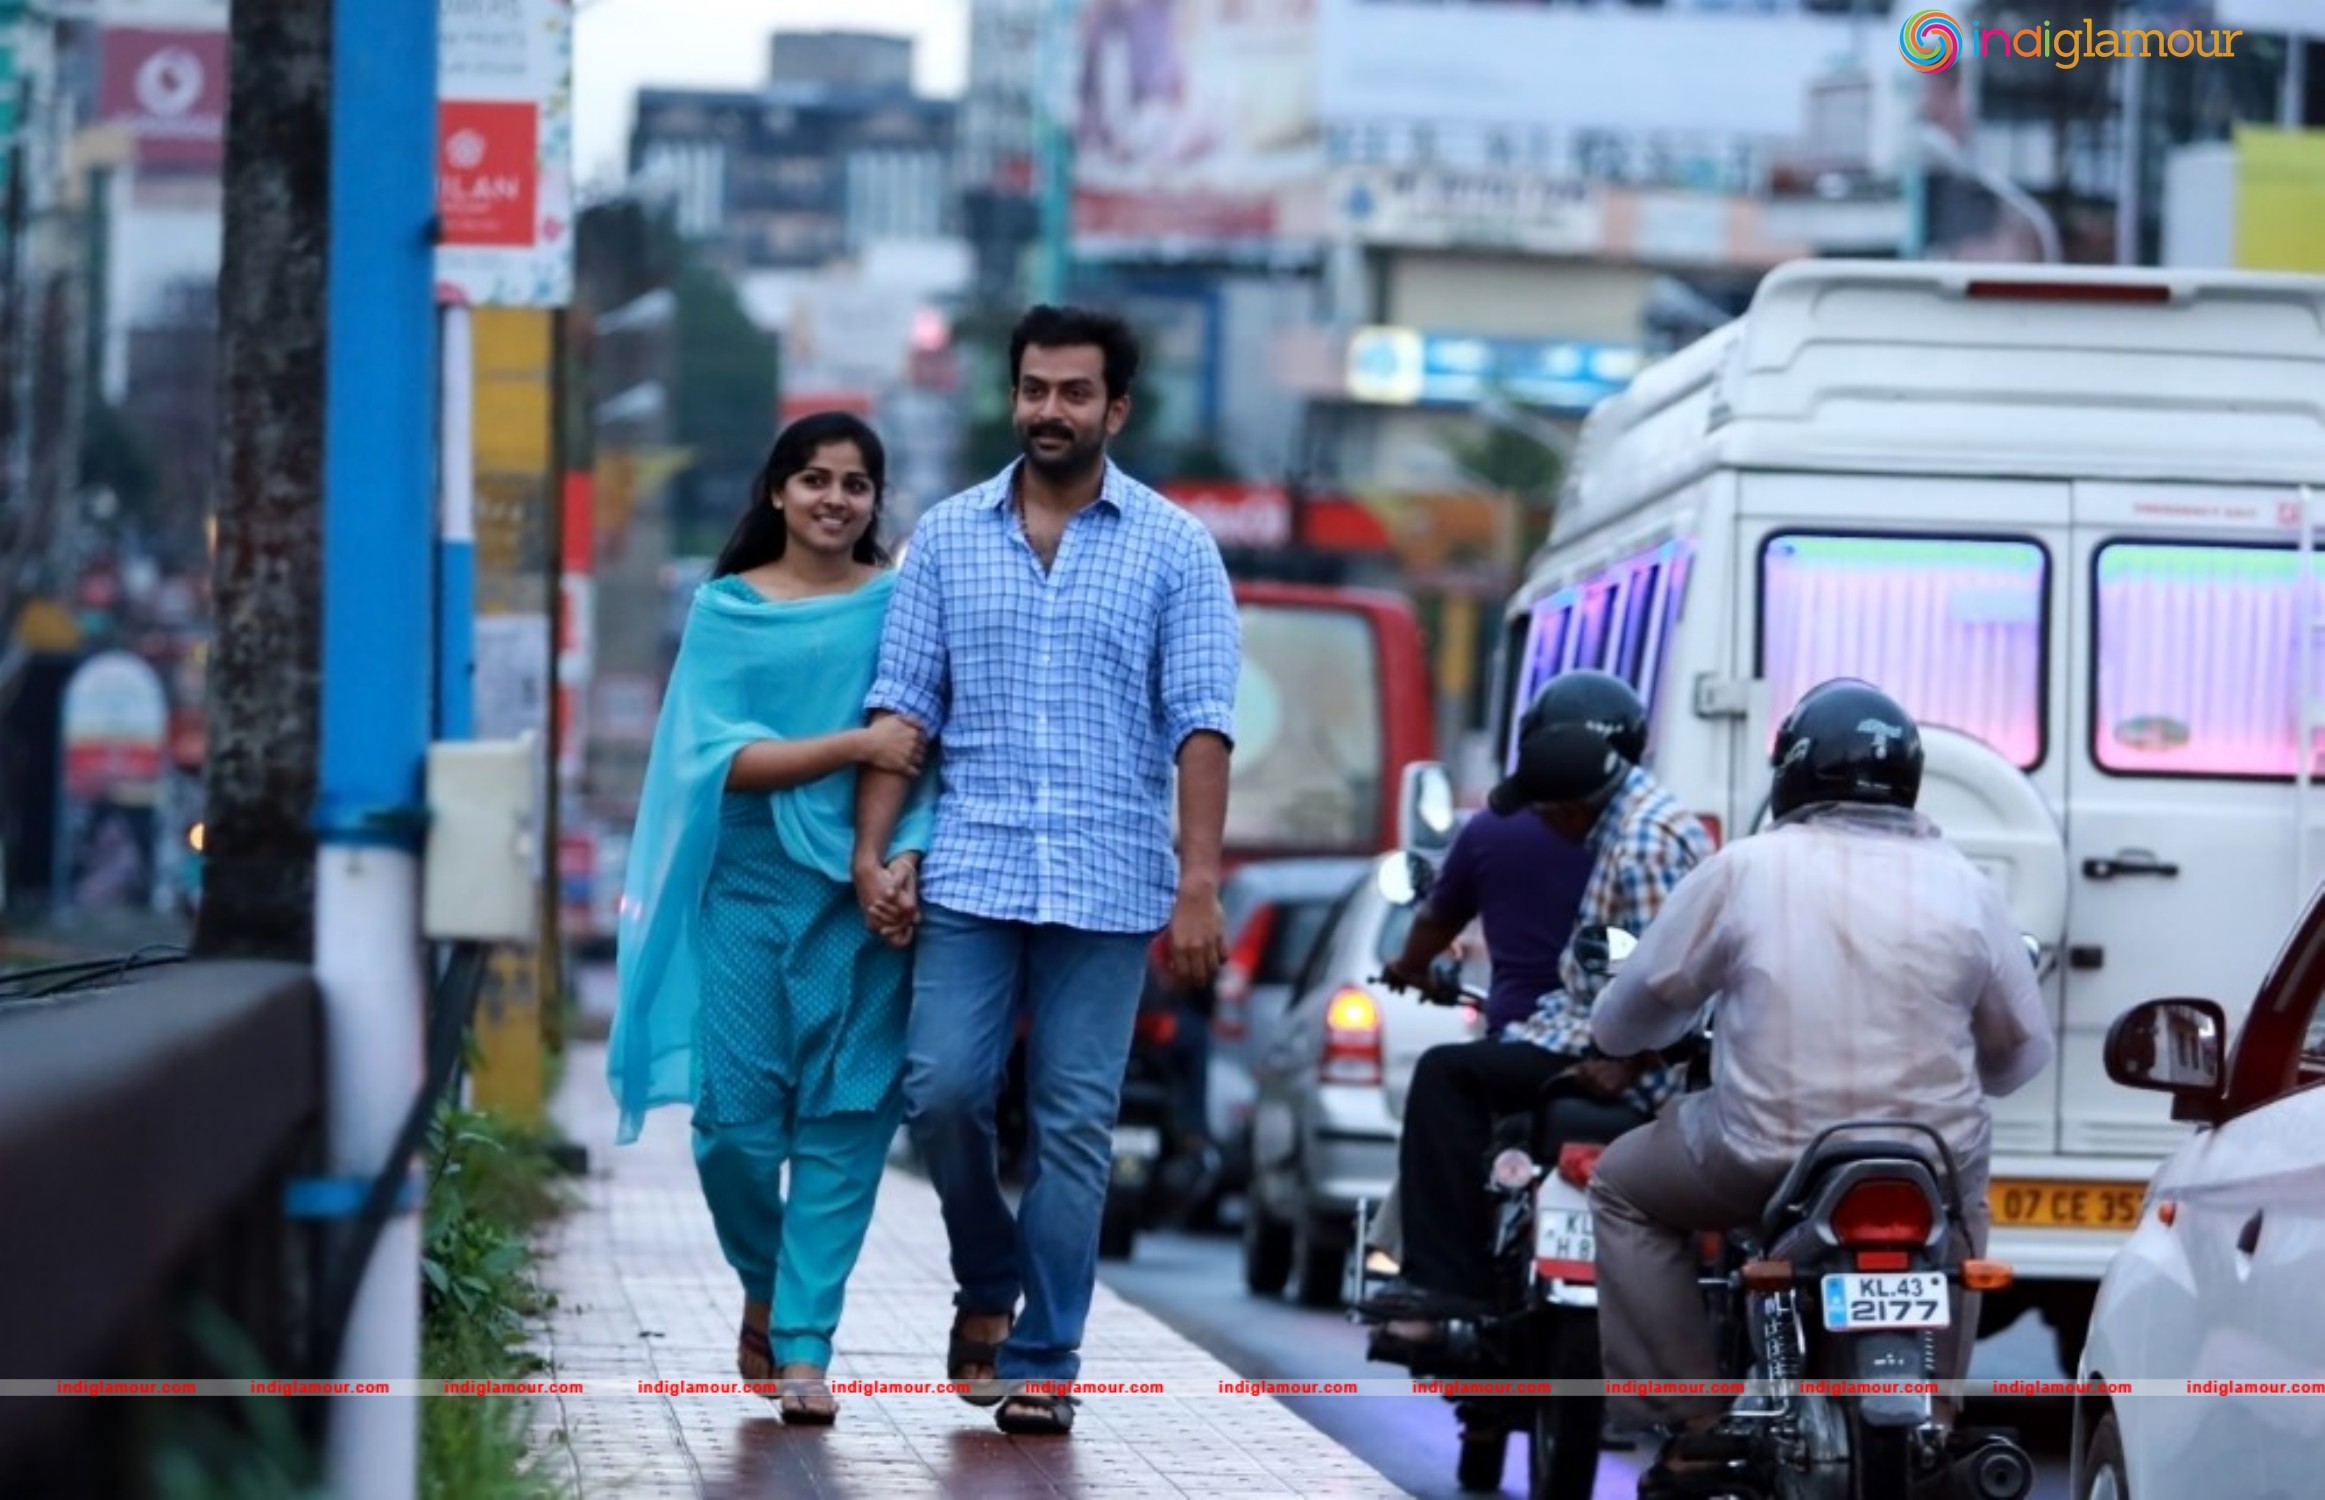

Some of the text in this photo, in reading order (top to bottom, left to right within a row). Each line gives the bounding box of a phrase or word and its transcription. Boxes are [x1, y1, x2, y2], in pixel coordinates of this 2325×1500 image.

[2003, 1189, 2145, 1218] 07 CE 35
[1859, 1278, 1924, 1297] KL.43
[1851, 1301, 1938, 1321] 2177
